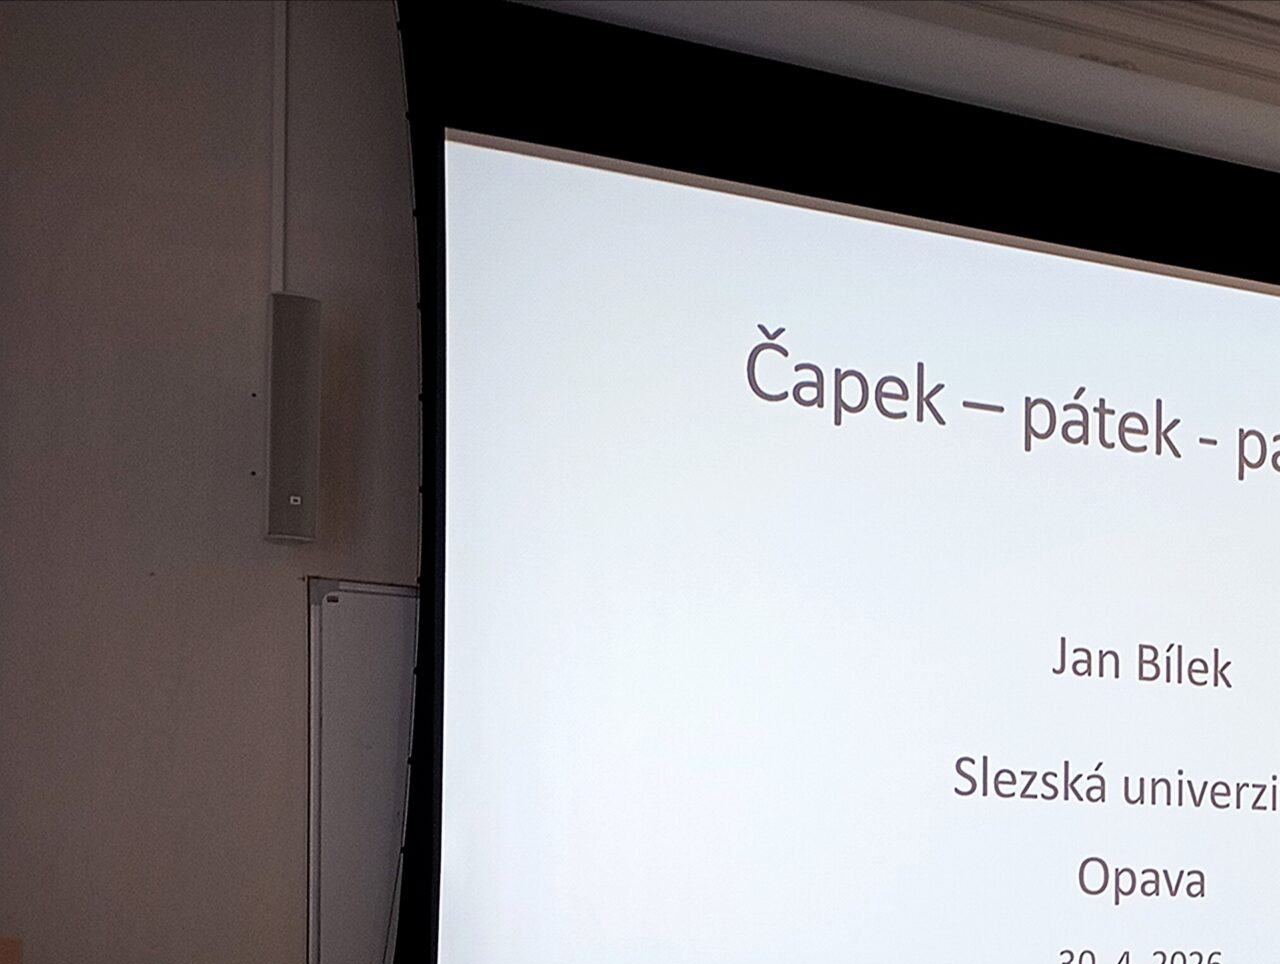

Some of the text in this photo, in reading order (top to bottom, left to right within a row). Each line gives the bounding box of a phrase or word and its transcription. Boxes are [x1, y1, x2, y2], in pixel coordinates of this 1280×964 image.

[745, 322, 948, 427] Čapek
[1023, 385, 1183, 460] pátek
[1051, 635, 1234, 690] Jan Bílek
[953, 754, 1107, 804] Slezská
[1077, 855, 1206, 907] Opava
